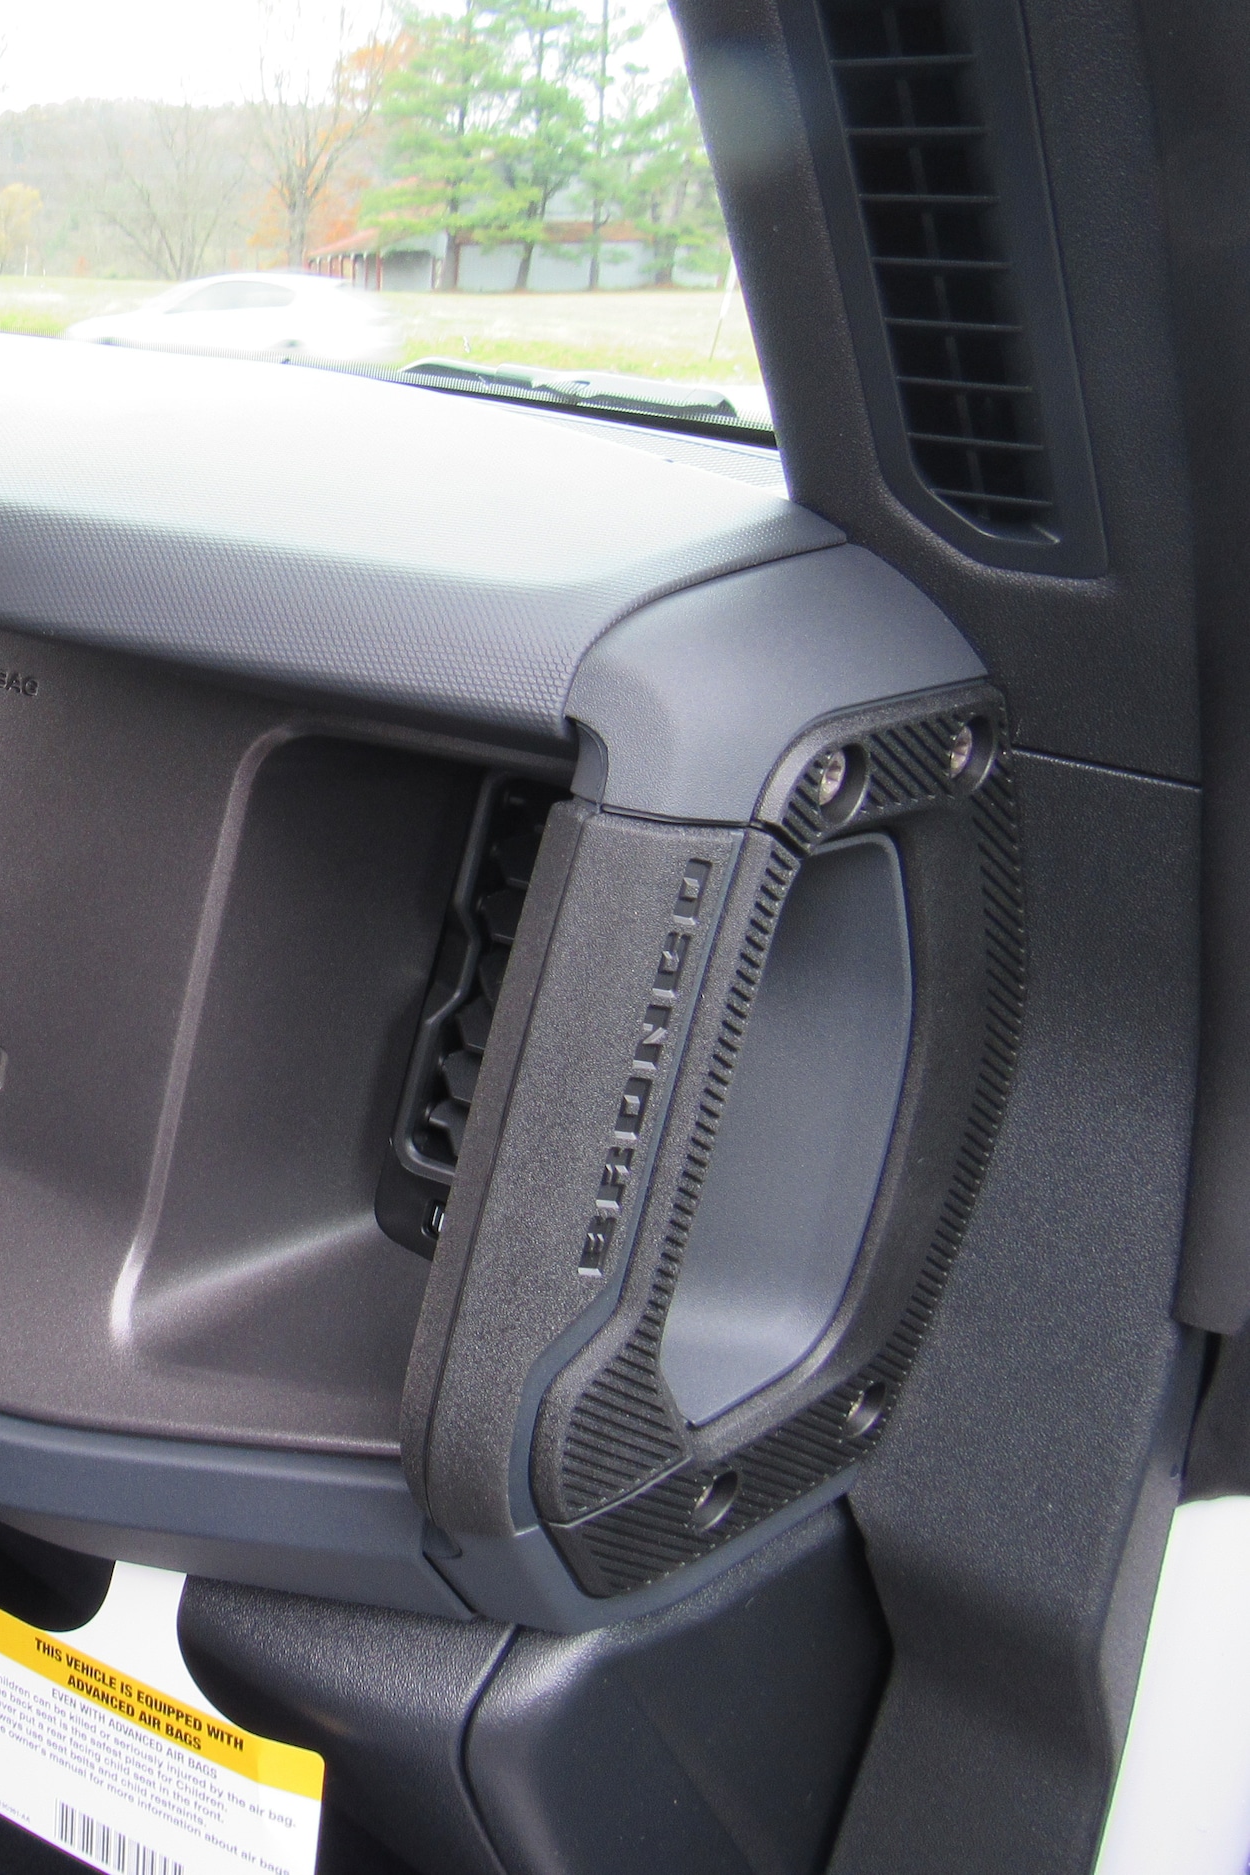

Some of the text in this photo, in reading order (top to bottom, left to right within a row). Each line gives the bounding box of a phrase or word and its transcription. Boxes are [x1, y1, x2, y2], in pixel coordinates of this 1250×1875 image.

[577, 858, 713, 1276] BRONCO
[10, 1691, 33, 1711] back
[36, 1707, 56, 1727] seat
[59, 1717, 67, 1731] is
[71, 1726, 87, 1741] the
[90, 1735, 122, 1759] safest
[125, 1754, 154, 1776] place
[157, 1769, 173, 1785] for
[176, 1780, 227, 1812] Children.
[35, 1637, 244, 1752] THIS VEHICLE IS EQUIPPED WITH
[52, 1688, 217, 1779] EVEN WITH ADVANCED AIR BAGS
[67, 1675, 202, 1750] ADVANCED AIR BAGS
[8, 1730, 47, 1756] owner's
[50, 1752, 87, 1778] manual
[90, 1772, 104, 1786] for
[107, 1783, 134, 1803] more
[137, 1796, 202, 1837] information
[204, 1832, 238, 1855] about
[241, 1850, 256, 1864] air
[19, 1710, 36, 1727] put
[38, 1722, 44, 1731] a
[47, 1727, 66, 1742] rear
[69, 1737, 101, 1762] facing
[104, 1756, 130, 1775] child
[133, 1772, 156, 1790] seat
[160, 1783, 169, 1796] in
[173, 1791, 190, 1806] the
[194, 1800, 224, 1823] front.
[26, 1728, 43, 1742] use
[46, 1739, 67, 1756] seat
[70, 1749, 95, 1770] belts
[98, 1767, 118, 1782] and
[120, 1776, 147, 1796] child
[150, 1794, 207, 1827] restraints.
[33, 1694, 51, 1710] can
[54, 1703, 67, 1717] be
[69, 1712, 97, 1734] killed
[100, 1730, 111, 1741] or
[113, 1735, 163, 1768] seriously
[167, 1762, 206, 1789] injured
[209, 1782, 224, 1798] by
[227, 1792, 246, 1808] the
[249, 1803, 265, 1816] air
[268, 1810, 296, 1828] bag.
